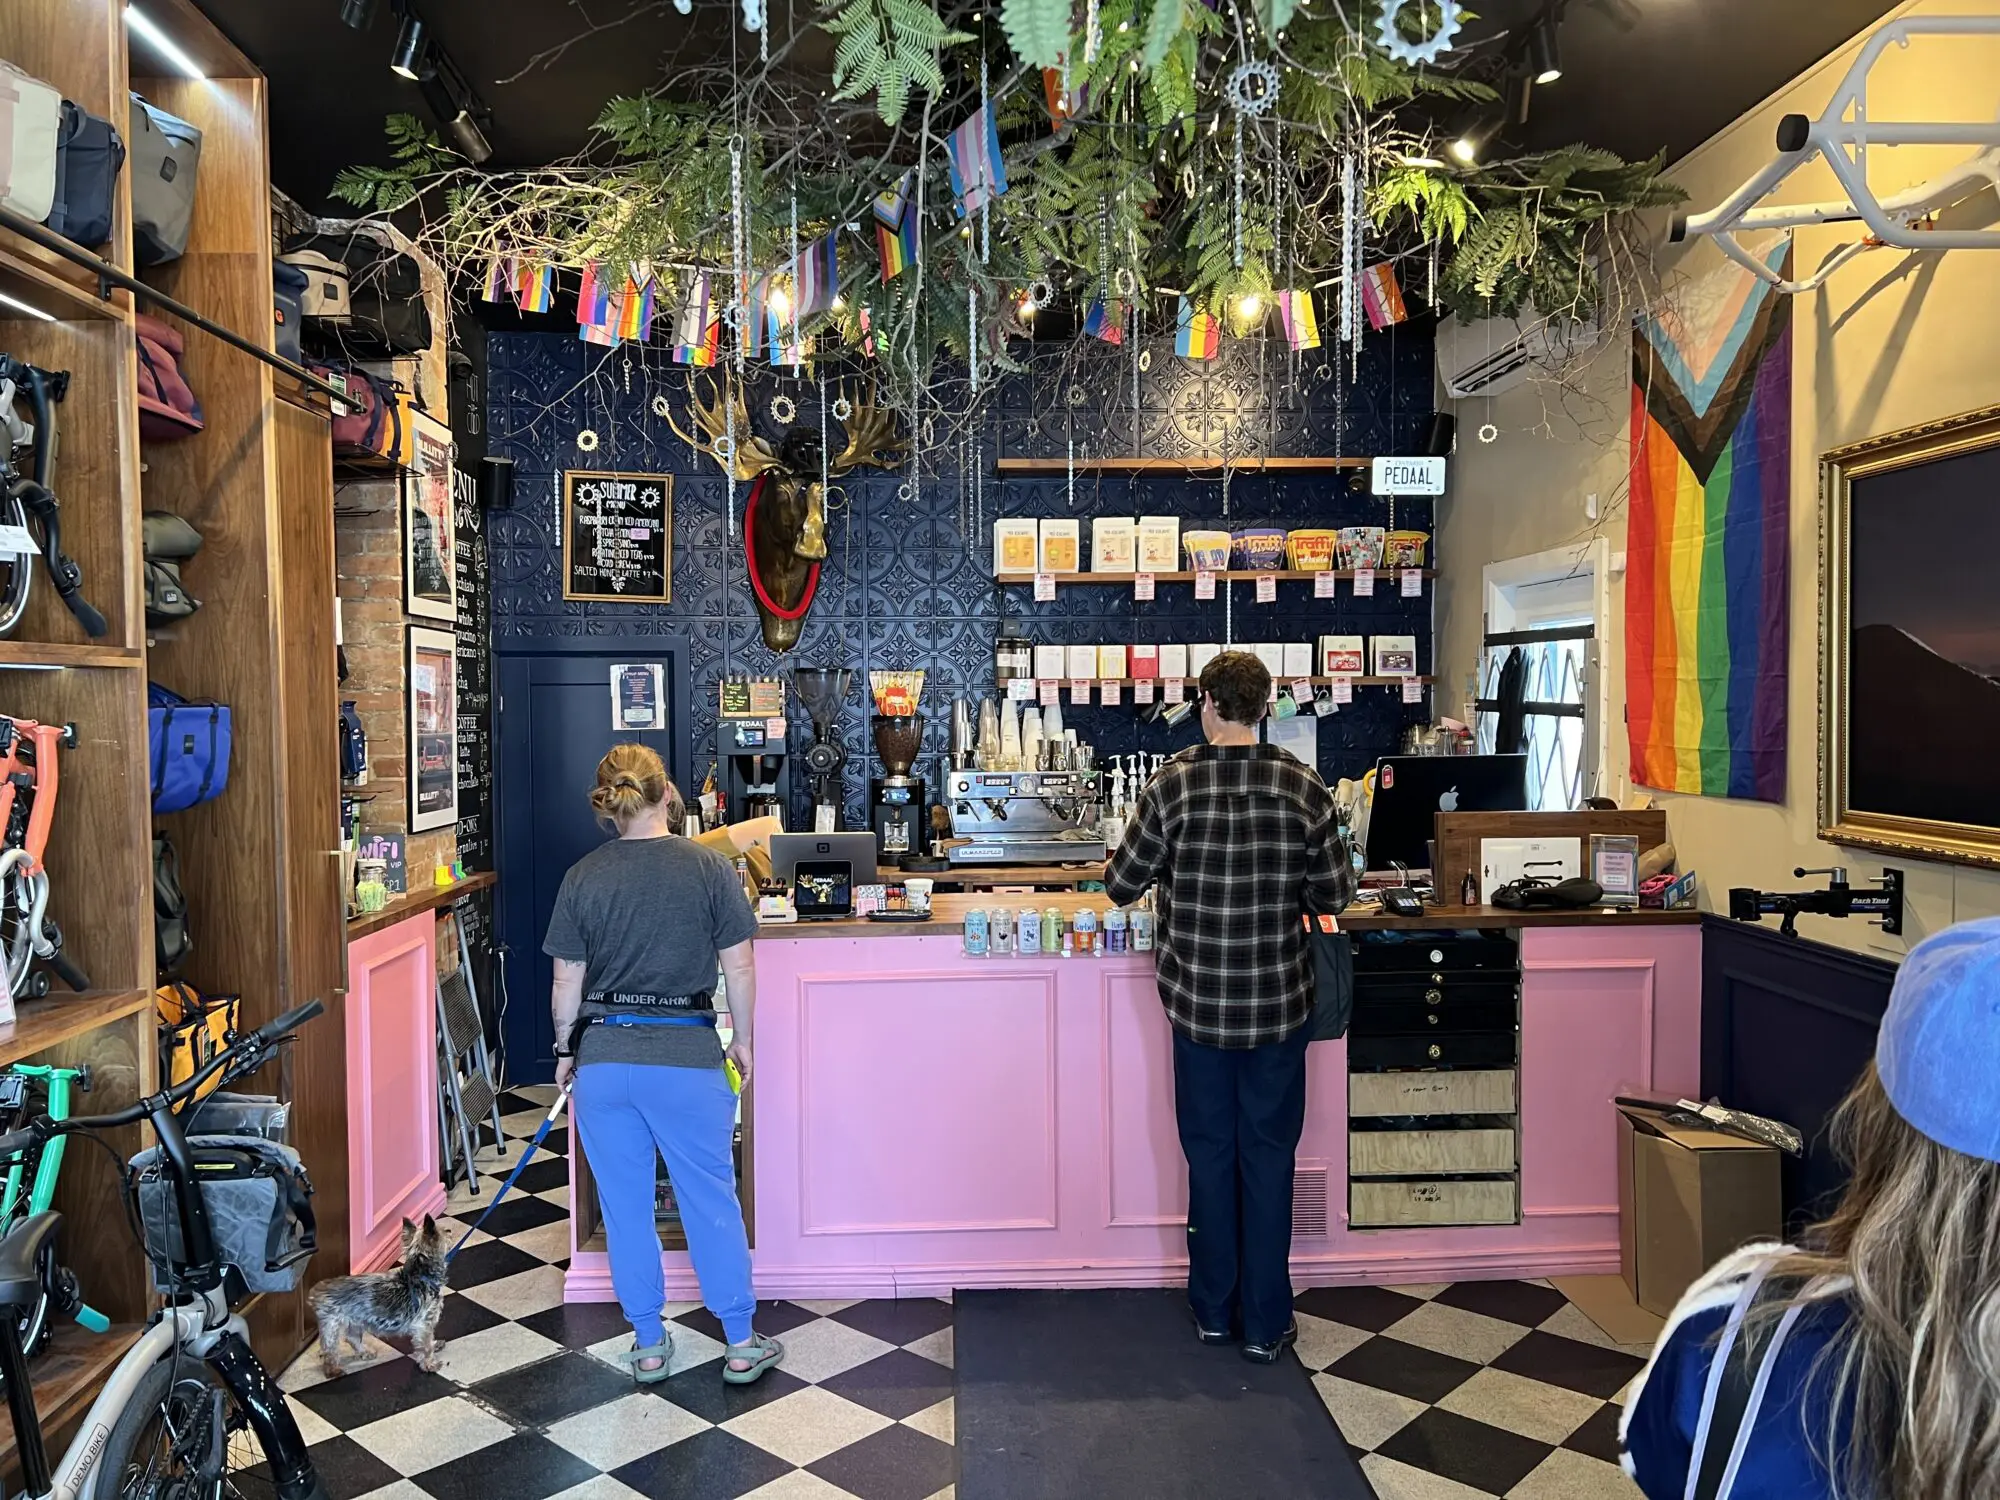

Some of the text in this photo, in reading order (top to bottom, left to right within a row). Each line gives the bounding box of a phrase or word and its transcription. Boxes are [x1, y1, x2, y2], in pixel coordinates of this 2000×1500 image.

[1385, 467, 1433, 485] PEDAAL
[600, 482, 637, 502] SUMMER
[456, 541, 471, 557] OFFEE
[574, 565, 598, 577] SALTED
[621, 570, 641, 578] LATTE
[457, 646, 477, 658] ericano
[613, 992, 656, 1005] UNDER
[658, 996, 691, 1006] ARM
[72, 1430, 106, 1487] DEMO BIKE
